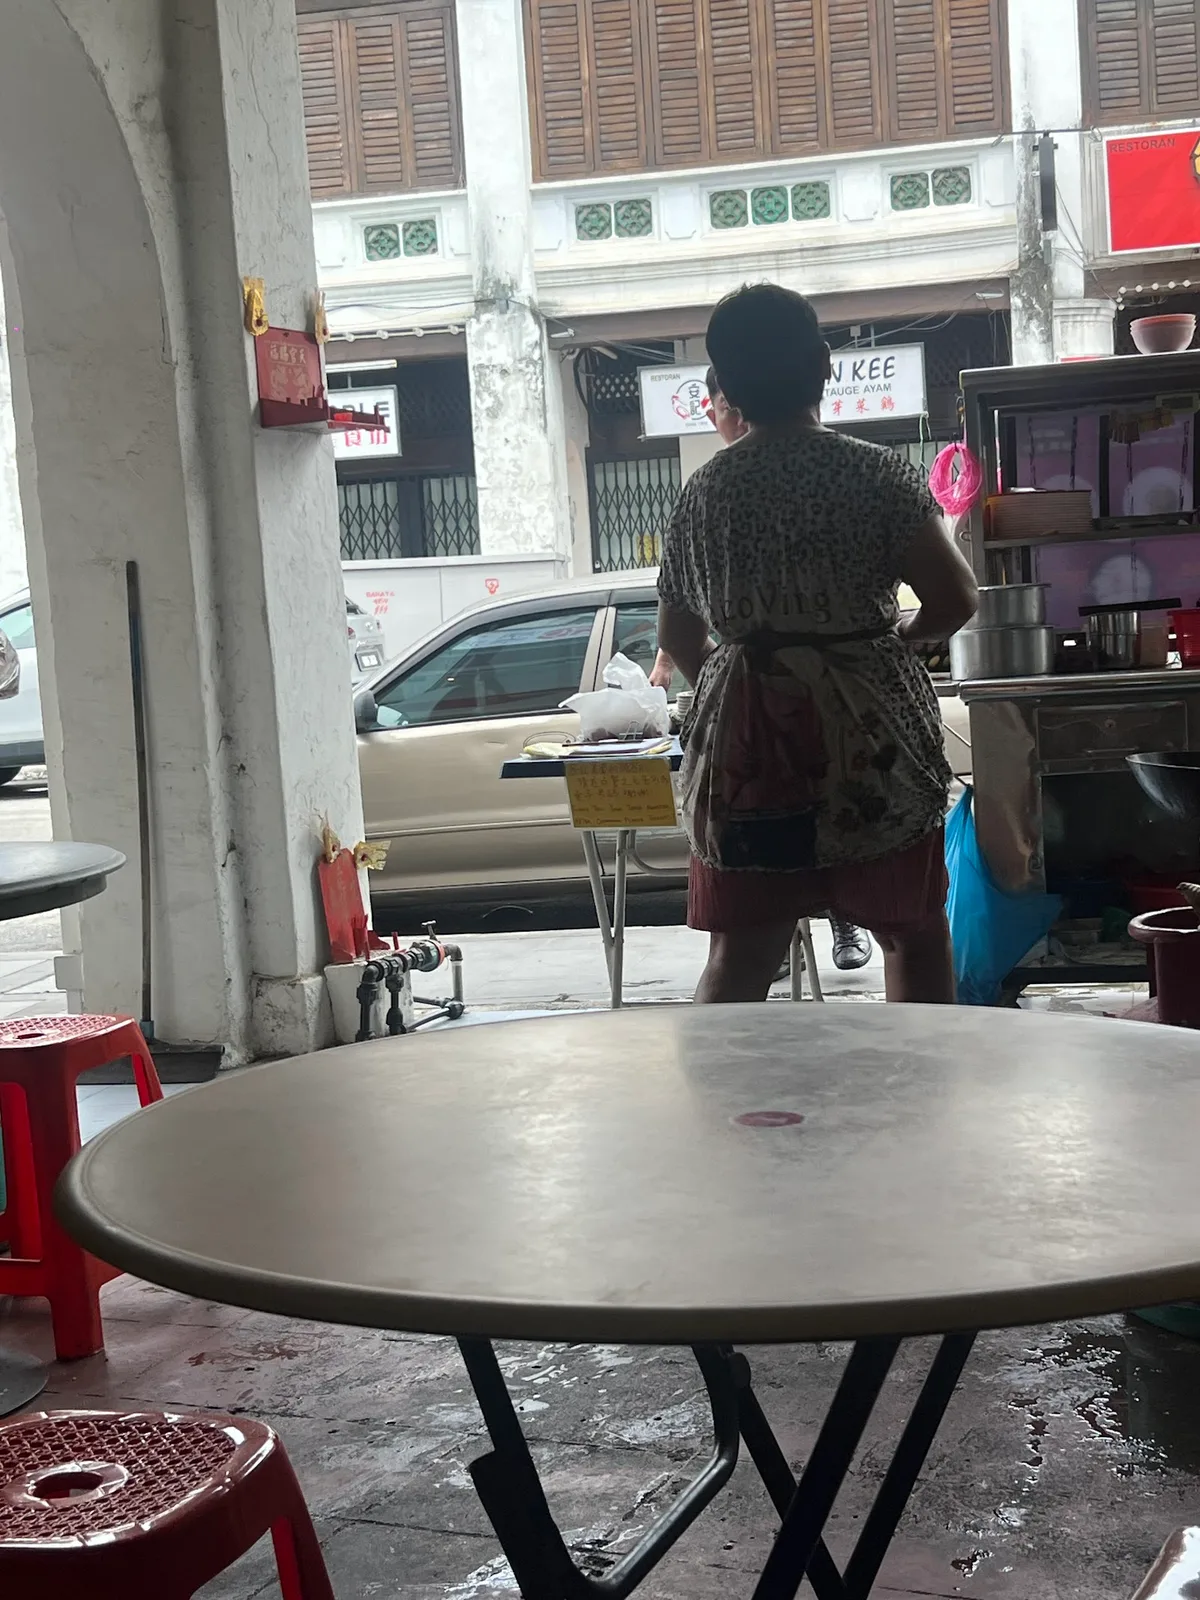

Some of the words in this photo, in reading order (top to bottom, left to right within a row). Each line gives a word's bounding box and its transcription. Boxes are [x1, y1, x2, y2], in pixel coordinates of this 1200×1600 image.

[1110, 138, 1176, 153] RESTORAN
[852, 356, 896, 382] KEE
[650, 373, 681, 382] RESTORAN
[825, 386, 860, 397] TAUGE
[863, 383, 892, 394] AYAM
